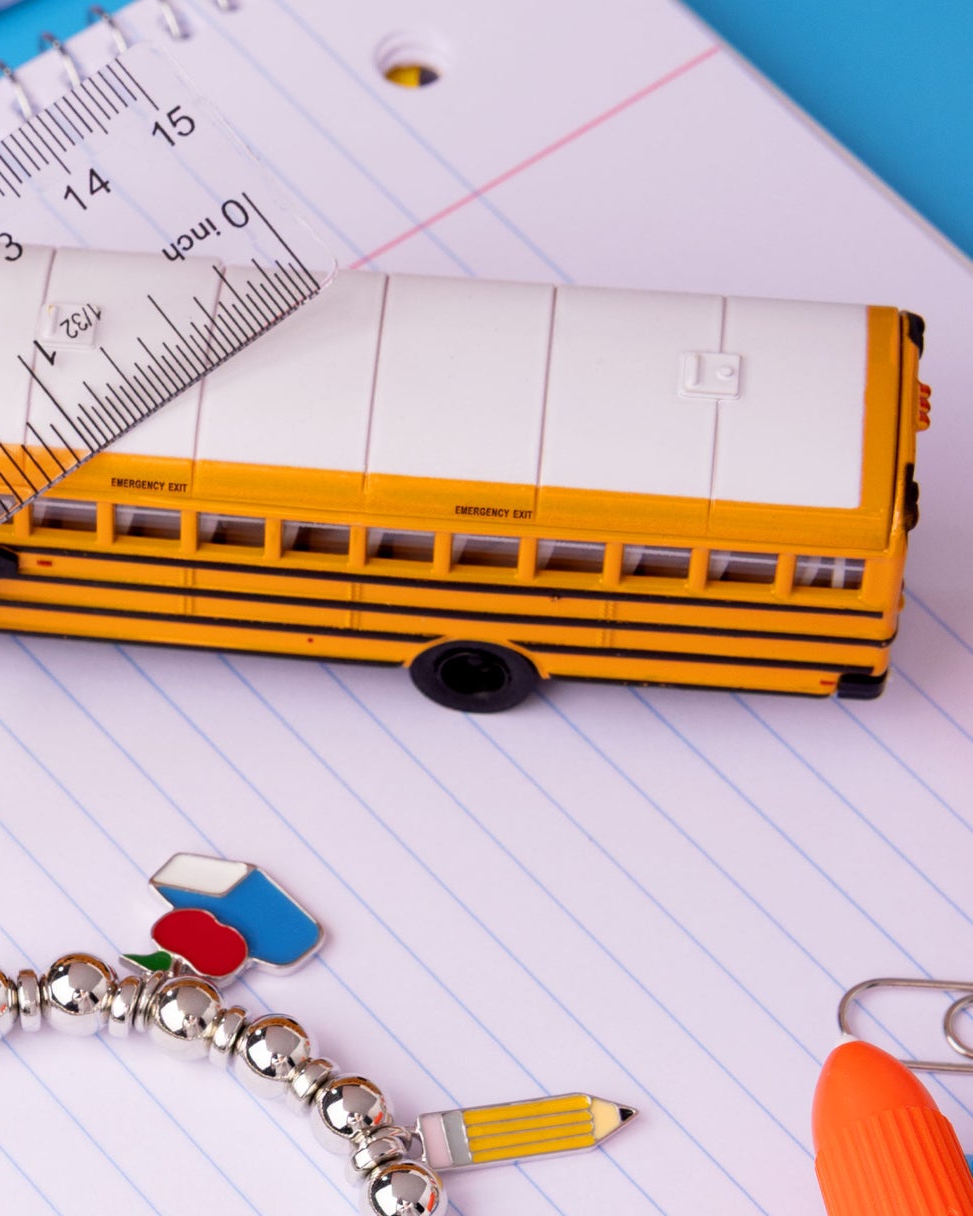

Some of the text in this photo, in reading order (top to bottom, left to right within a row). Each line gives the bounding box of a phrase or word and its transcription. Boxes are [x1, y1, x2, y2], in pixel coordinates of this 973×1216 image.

[64, 168, 111, 210] 14
[152, 105, 196, 146] 15
[162, 199, 249, 261] 0 inch
[60, 303, 102, 339] 1/32
[33, 340, 57, 366] 1
[111, 477, 188, 493] EMERGENCY EXIT
[455, 505, 533, 519] EMERGENCY EXIT
